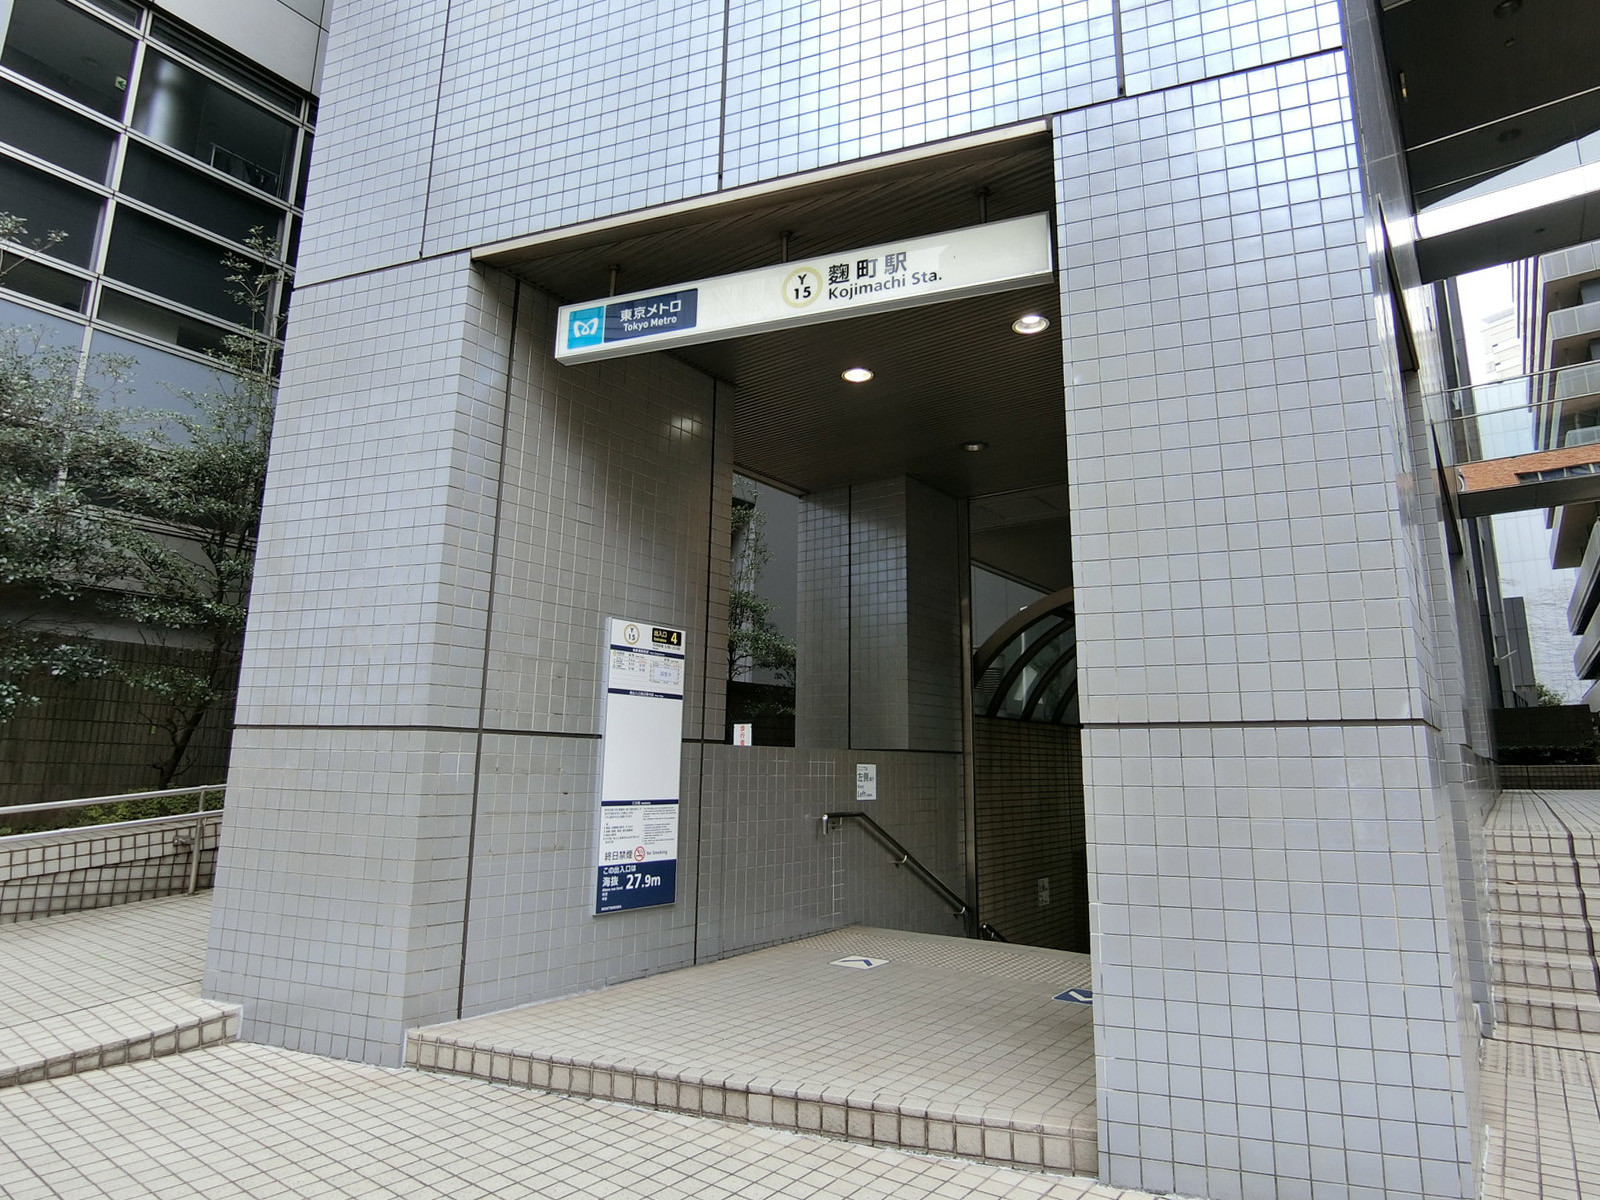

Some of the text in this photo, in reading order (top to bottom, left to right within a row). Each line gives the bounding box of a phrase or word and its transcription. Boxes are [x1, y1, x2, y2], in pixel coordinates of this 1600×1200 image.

[798, 274, 807, 286] Y
[828, 270, 943, 301] Kojimachi Sta.
[794, 286, 811, 300] 15
[620, 300, 682, 323] 東京メトロ
[623, 316, 677, 332] Tokyo Metro
[671, 633, 678, 644] 4
[603, 865, 637, 875] この出入口は
[626, 874, 661, 890] 27.9m
